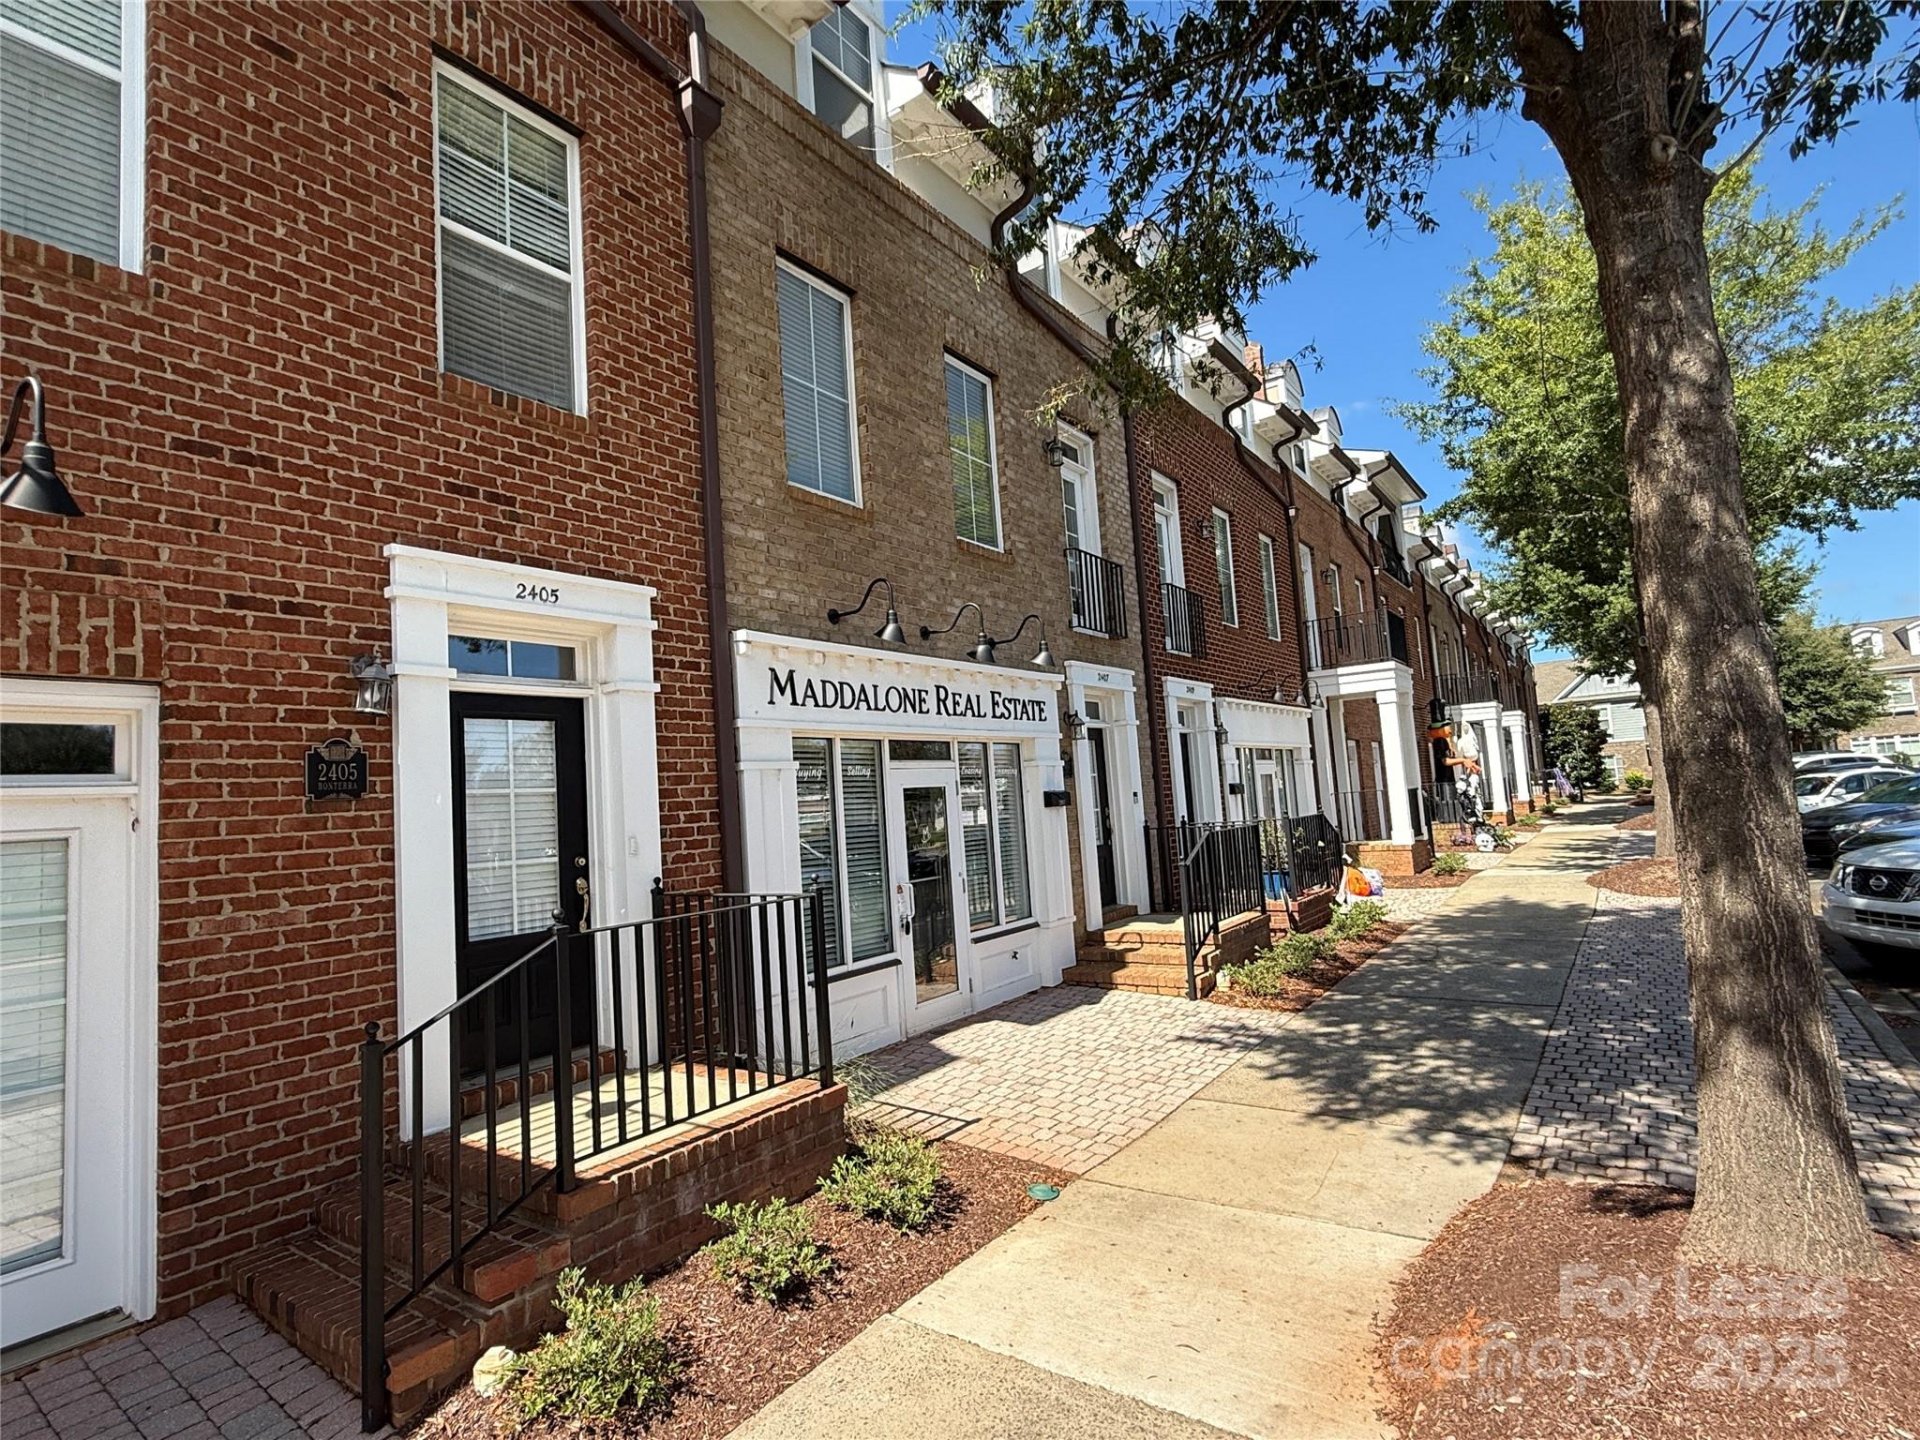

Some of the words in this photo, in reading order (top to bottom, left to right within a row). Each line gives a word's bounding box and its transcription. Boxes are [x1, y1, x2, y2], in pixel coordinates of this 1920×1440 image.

[516, 583, 559, 603] 2405
[768, 667, 930, 715] MADDALONE
[934, 684, 987, 718] REAL
[990, 690, 1048, 722] ESTATE
[318, 763, 358, 781] 2405
[797, 766, 824, 781] uying
[847, 765, 871, 779] Selling
